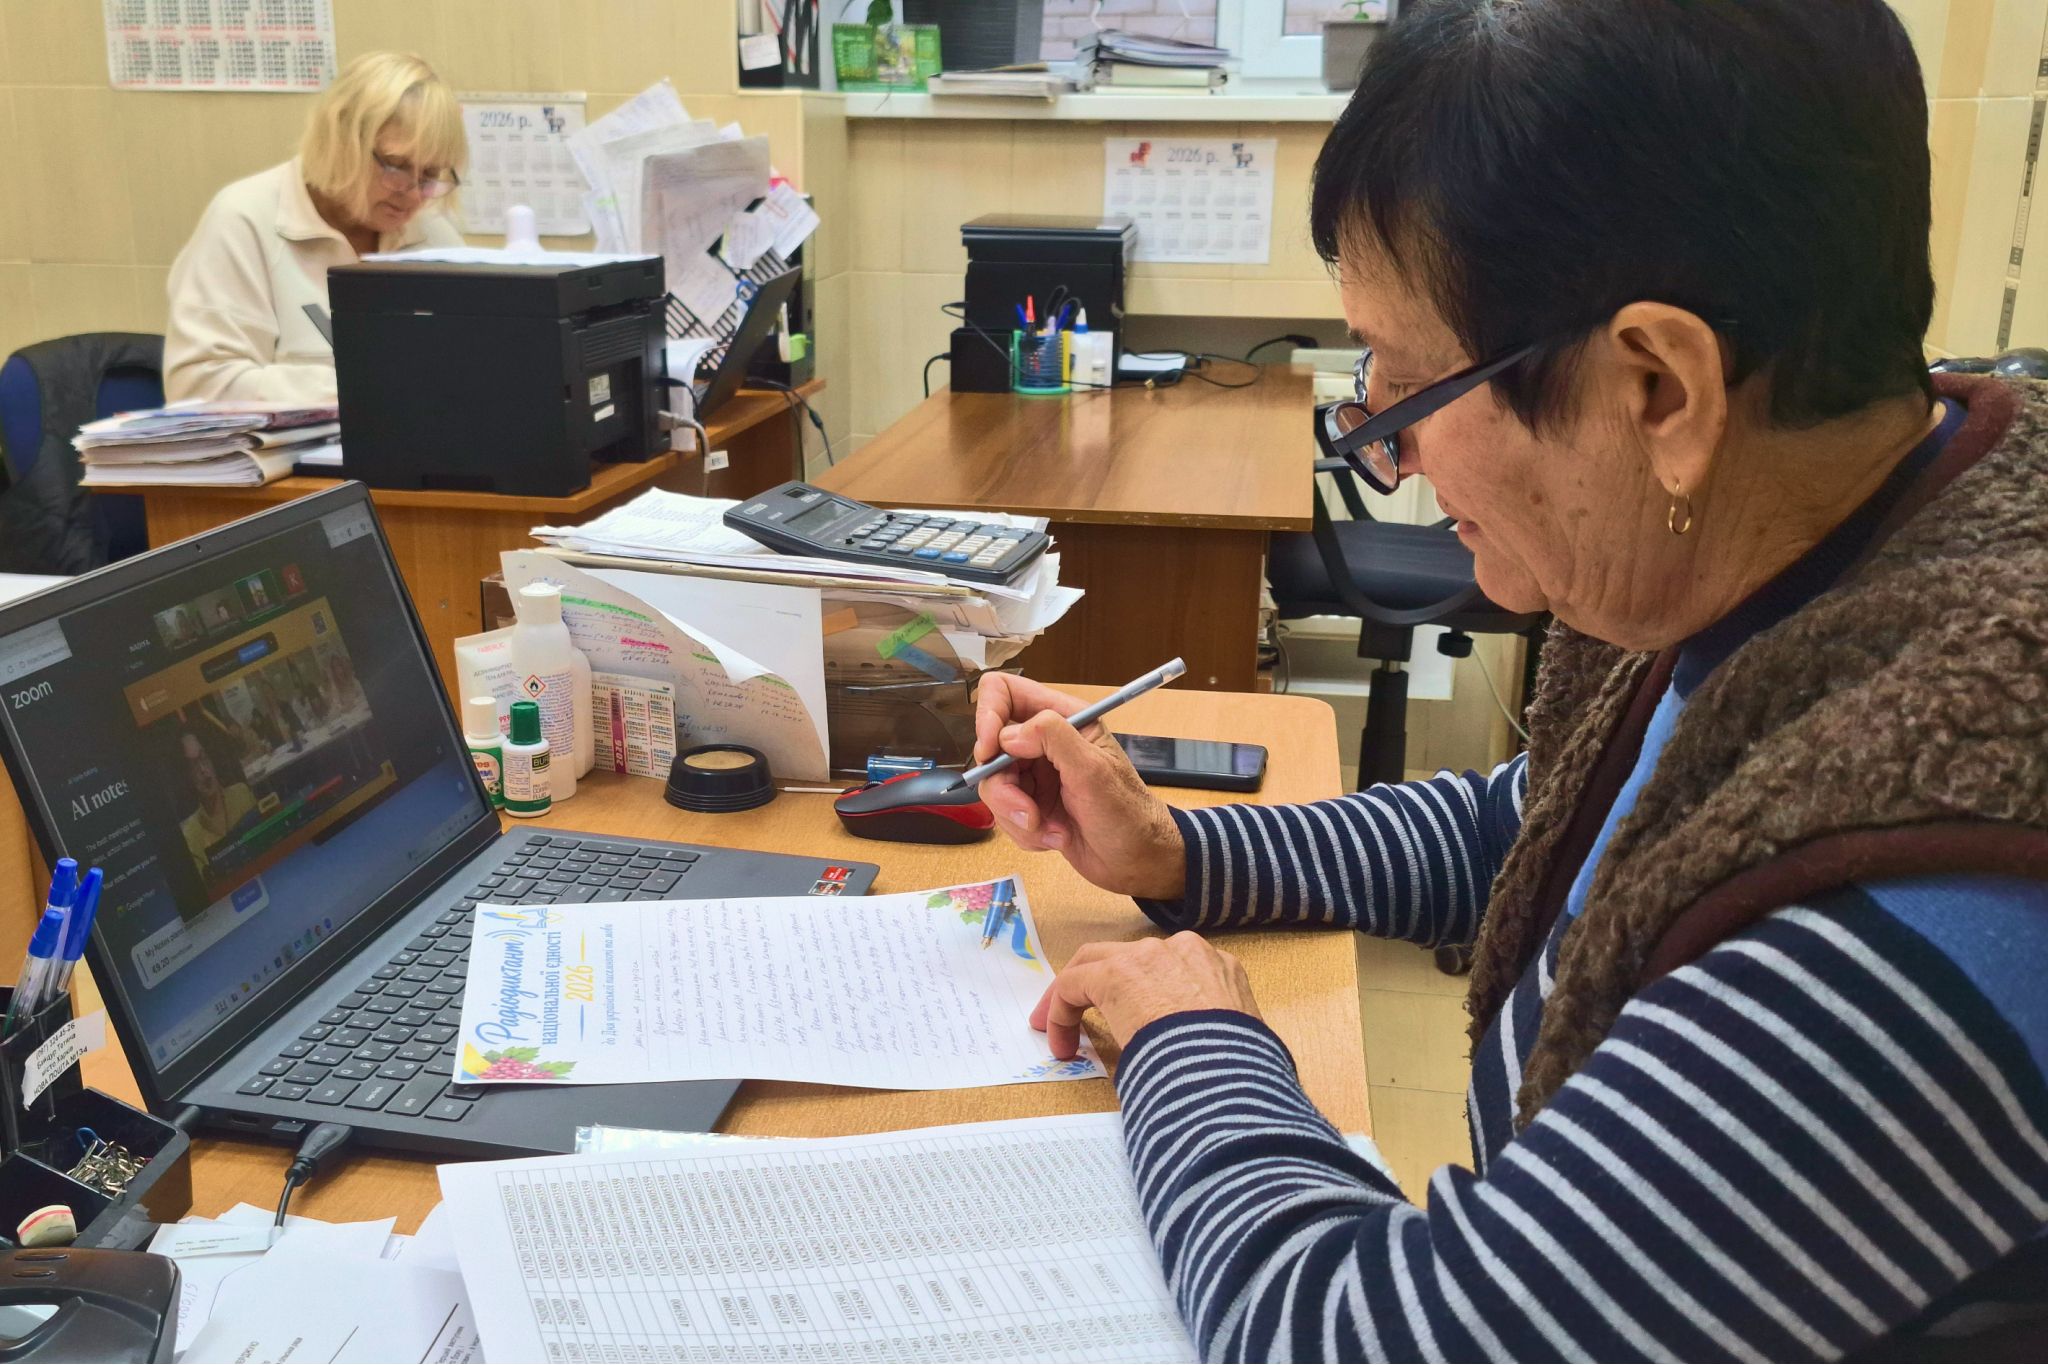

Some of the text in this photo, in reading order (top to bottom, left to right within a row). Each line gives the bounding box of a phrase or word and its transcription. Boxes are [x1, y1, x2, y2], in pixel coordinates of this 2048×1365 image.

[480, 111, 514, 128] 2026
[1167, 147, 1202, 163] 2026
[11, 680, 53, 709] zoom
[614, 739, 624, 767] 2026
[70, 793, 90, 821] AI
[602, 950, 615, 984] писемності
[475, 939, 539, 1044] Радіодиктант
[537, 931, 562, 1045] національної єдності
[564, 965, 594, 1001] 2026
[602, 984, 622, 1021] української
[601, 1022, 618, 1036] Дня
[33, 1078, 49, 1096] НОВА
[49, 1060, 70, 1081] ПОШТА
